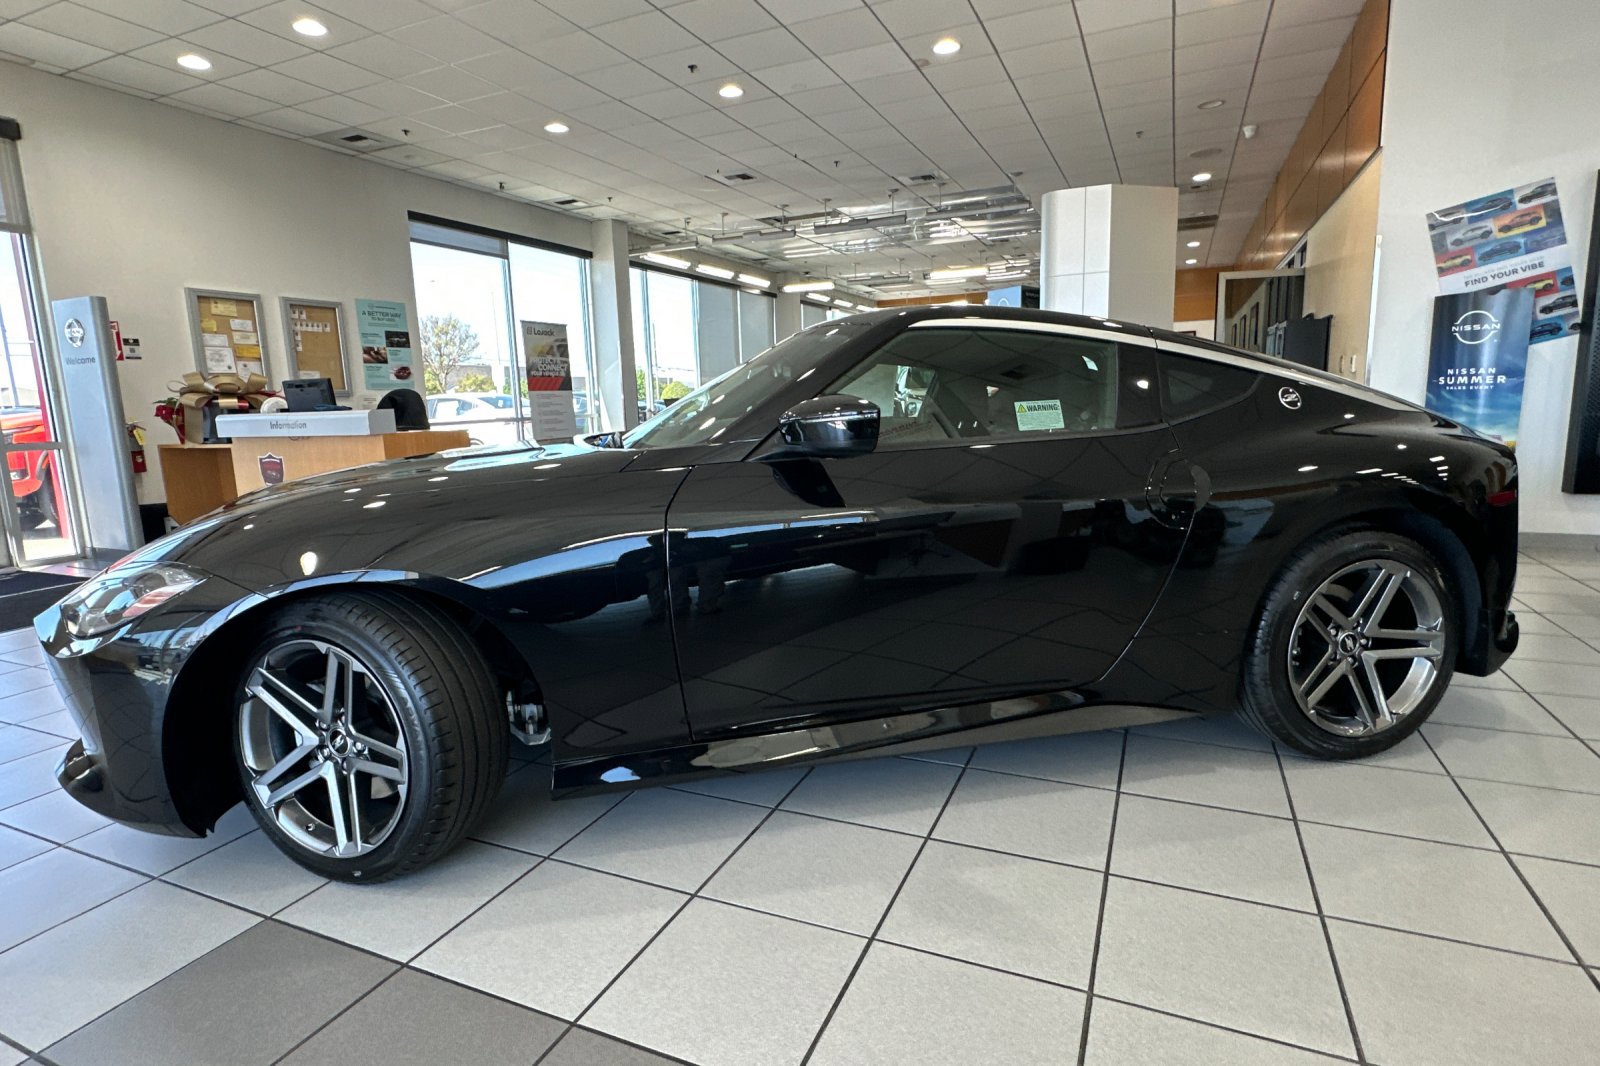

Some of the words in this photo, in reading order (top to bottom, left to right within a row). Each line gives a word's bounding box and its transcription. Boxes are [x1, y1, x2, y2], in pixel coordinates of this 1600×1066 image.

[1464, 276, 1488, 288] FIND
[1490, 268, 1519, 280] YOUR
[1520, 261, 1545, 273] VIBE
[1451, 323, 1501, 332] NISSAN
[65, 356, 96, 365] Welcome
[538, 363, 568, 372] CONNECT
[1447, 367, 1496, 375] NISSAN
[1438, 374, 1507, 385] SUMMER
[269, 421, 307, 430] Information
